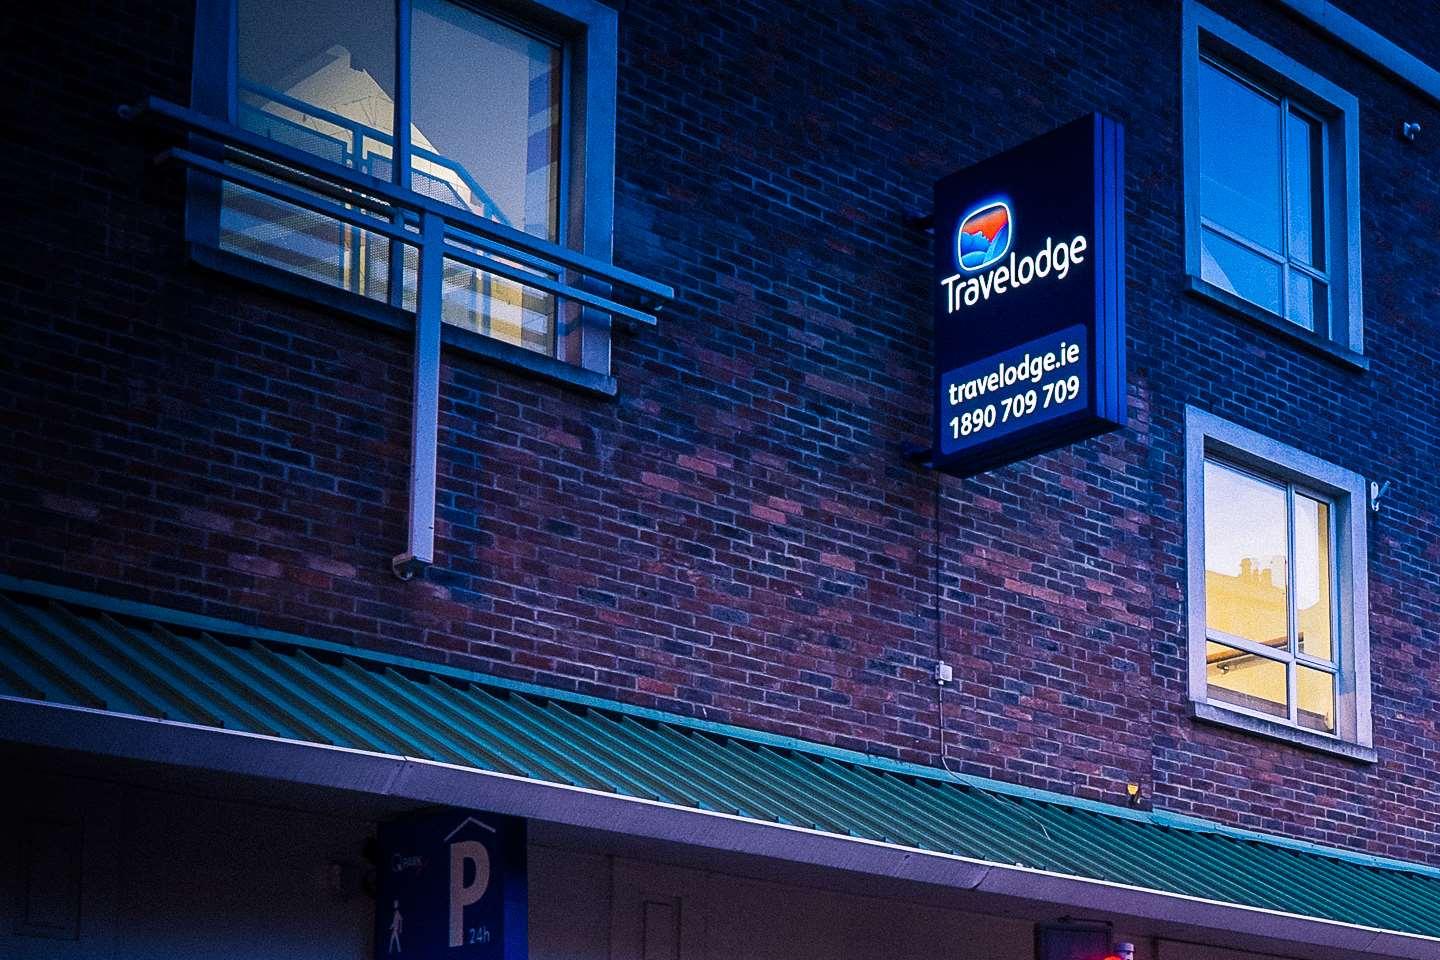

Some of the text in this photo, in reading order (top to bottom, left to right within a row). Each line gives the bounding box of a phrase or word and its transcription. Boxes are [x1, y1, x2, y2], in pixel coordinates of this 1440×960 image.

[941, 235, 1087, 314] Travelodge
[948, 341, 1080, 405] travelodge.ie
[949, 375, 1080, 439] 1890 709 709
[448, 840, 491, 948] P
[468, 925, 491, 944] 24h
